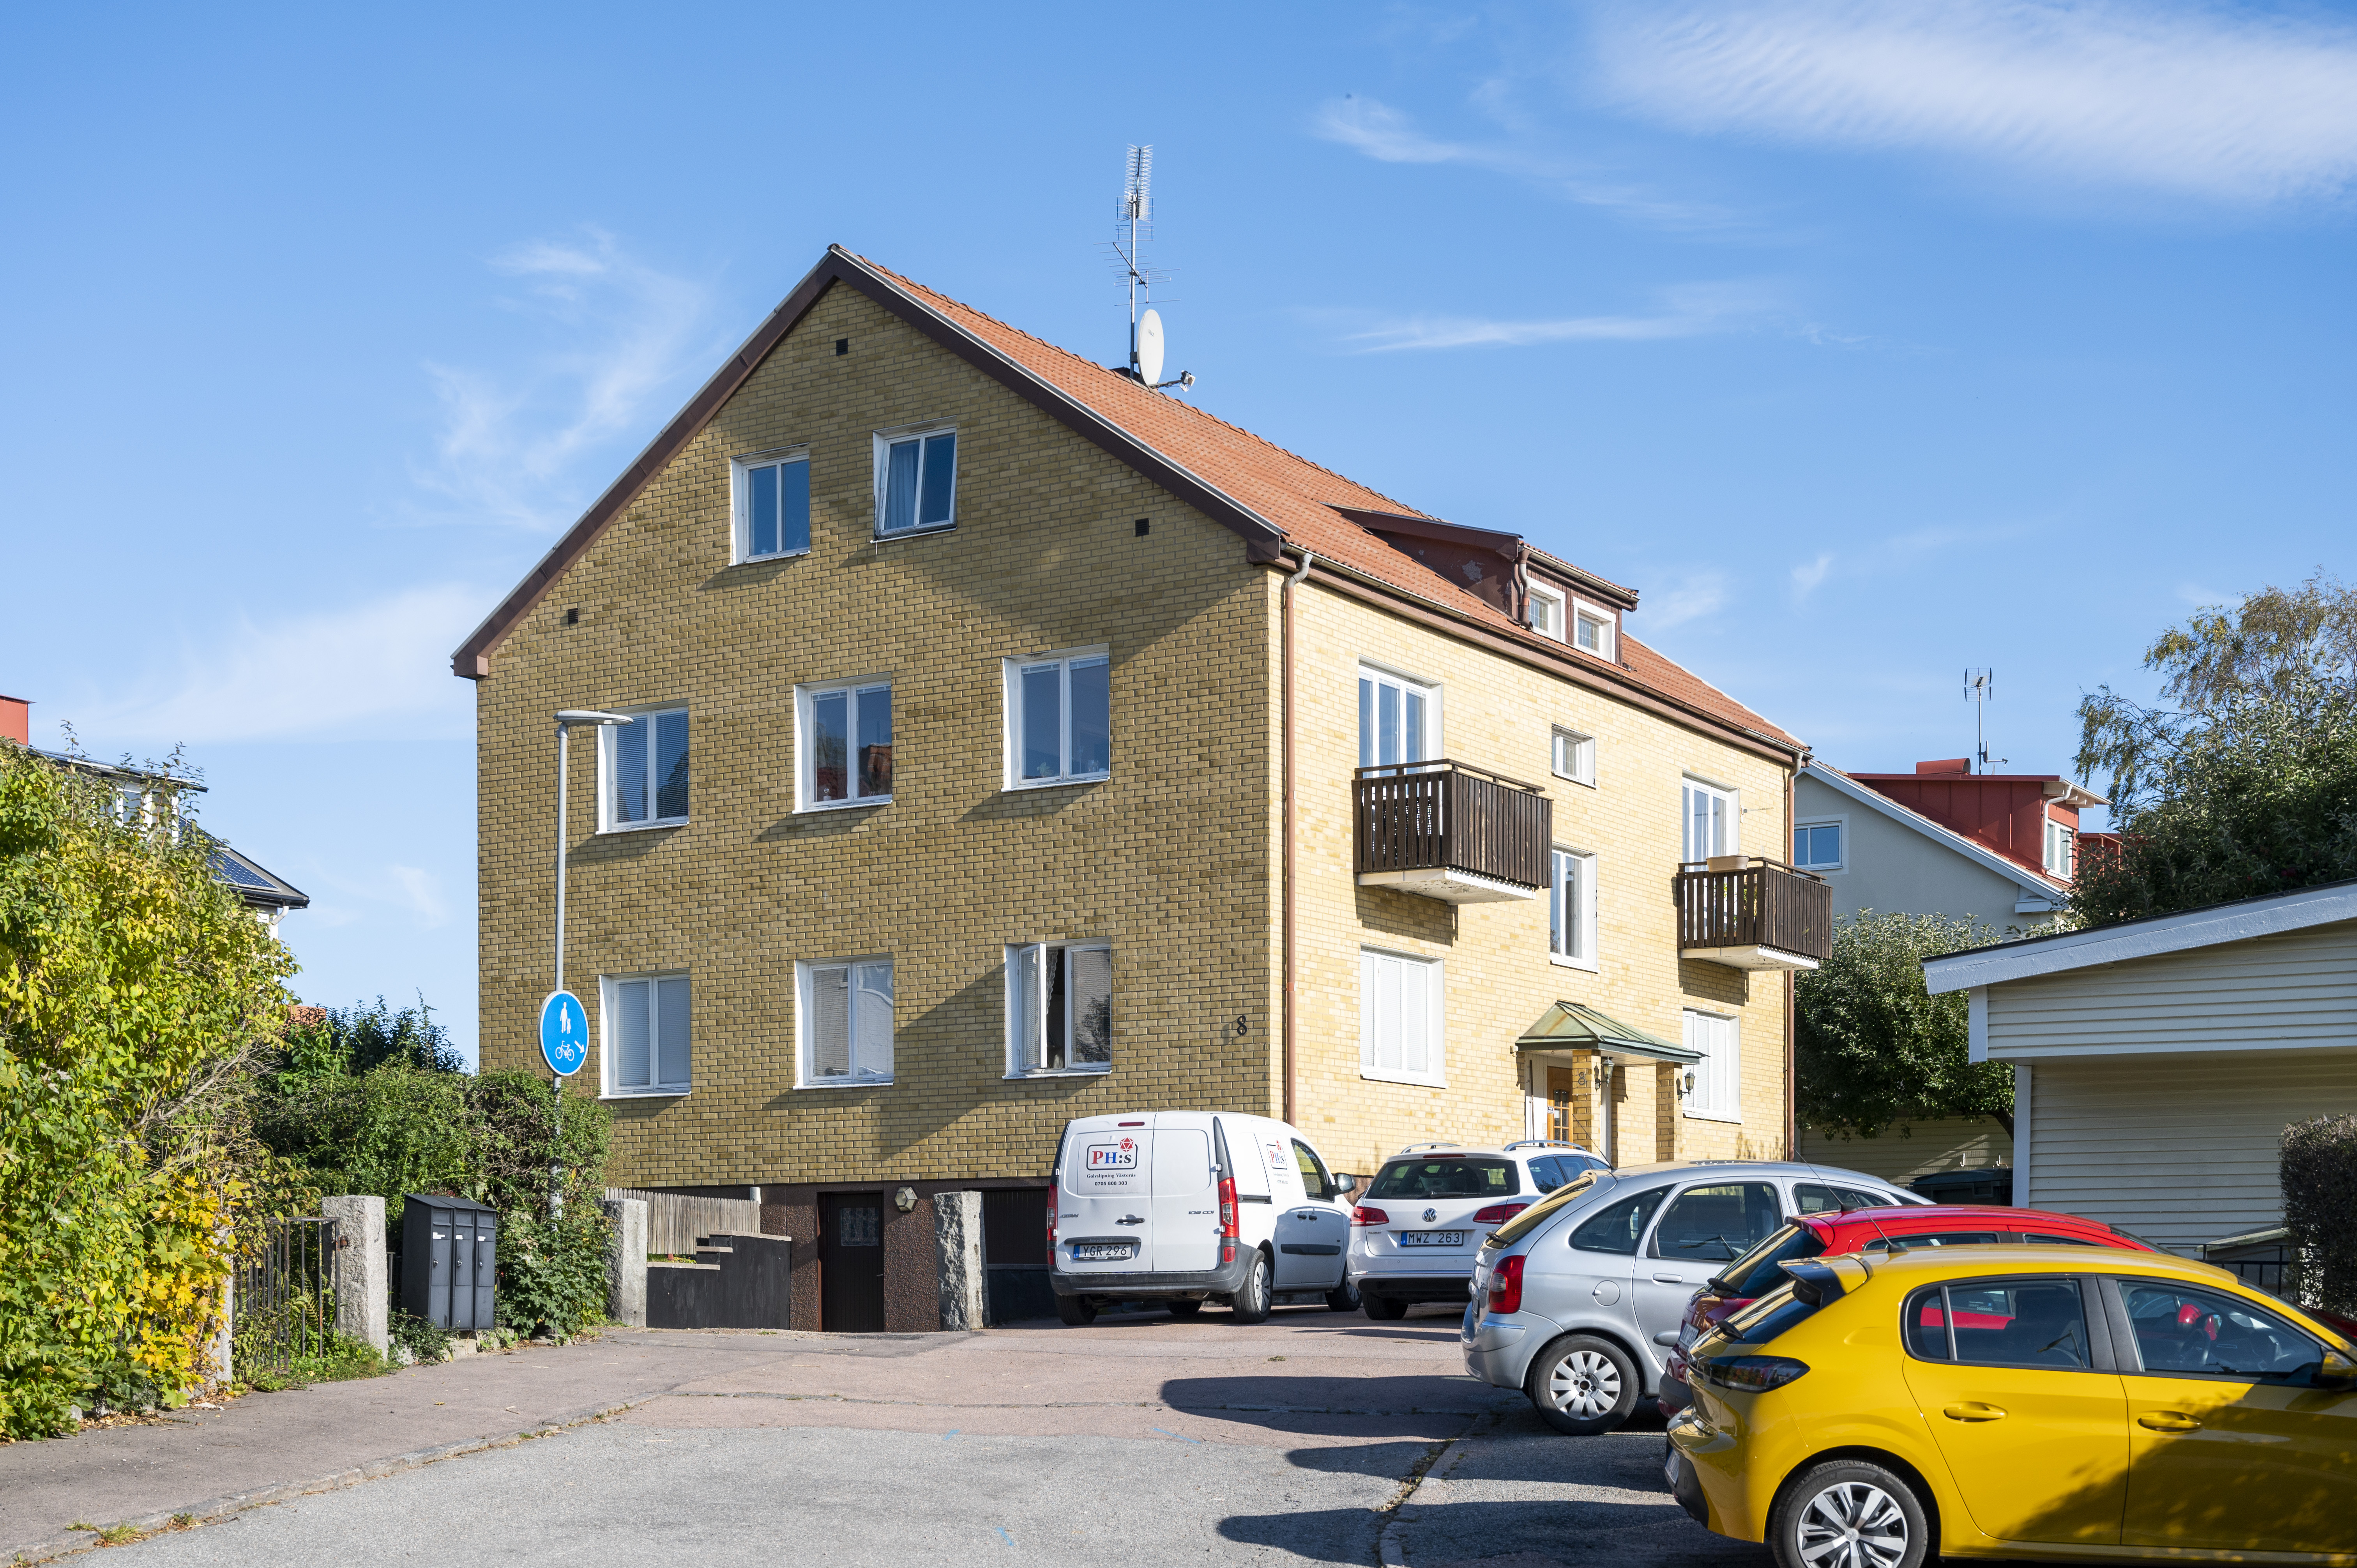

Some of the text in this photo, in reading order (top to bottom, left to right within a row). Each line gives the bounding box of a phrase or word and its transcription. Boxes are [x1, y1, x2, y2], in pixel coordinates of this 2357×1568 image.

[1237, 1015, 1247, 1035] 8
[1578, 1072, 1586, 1085] 8
[1092, 1151, 1131, 1164] PH:s
[1408, 1233, 1460, 1243] MWZ 263
[1083, 1245, 1127, 1256] YGR 296
